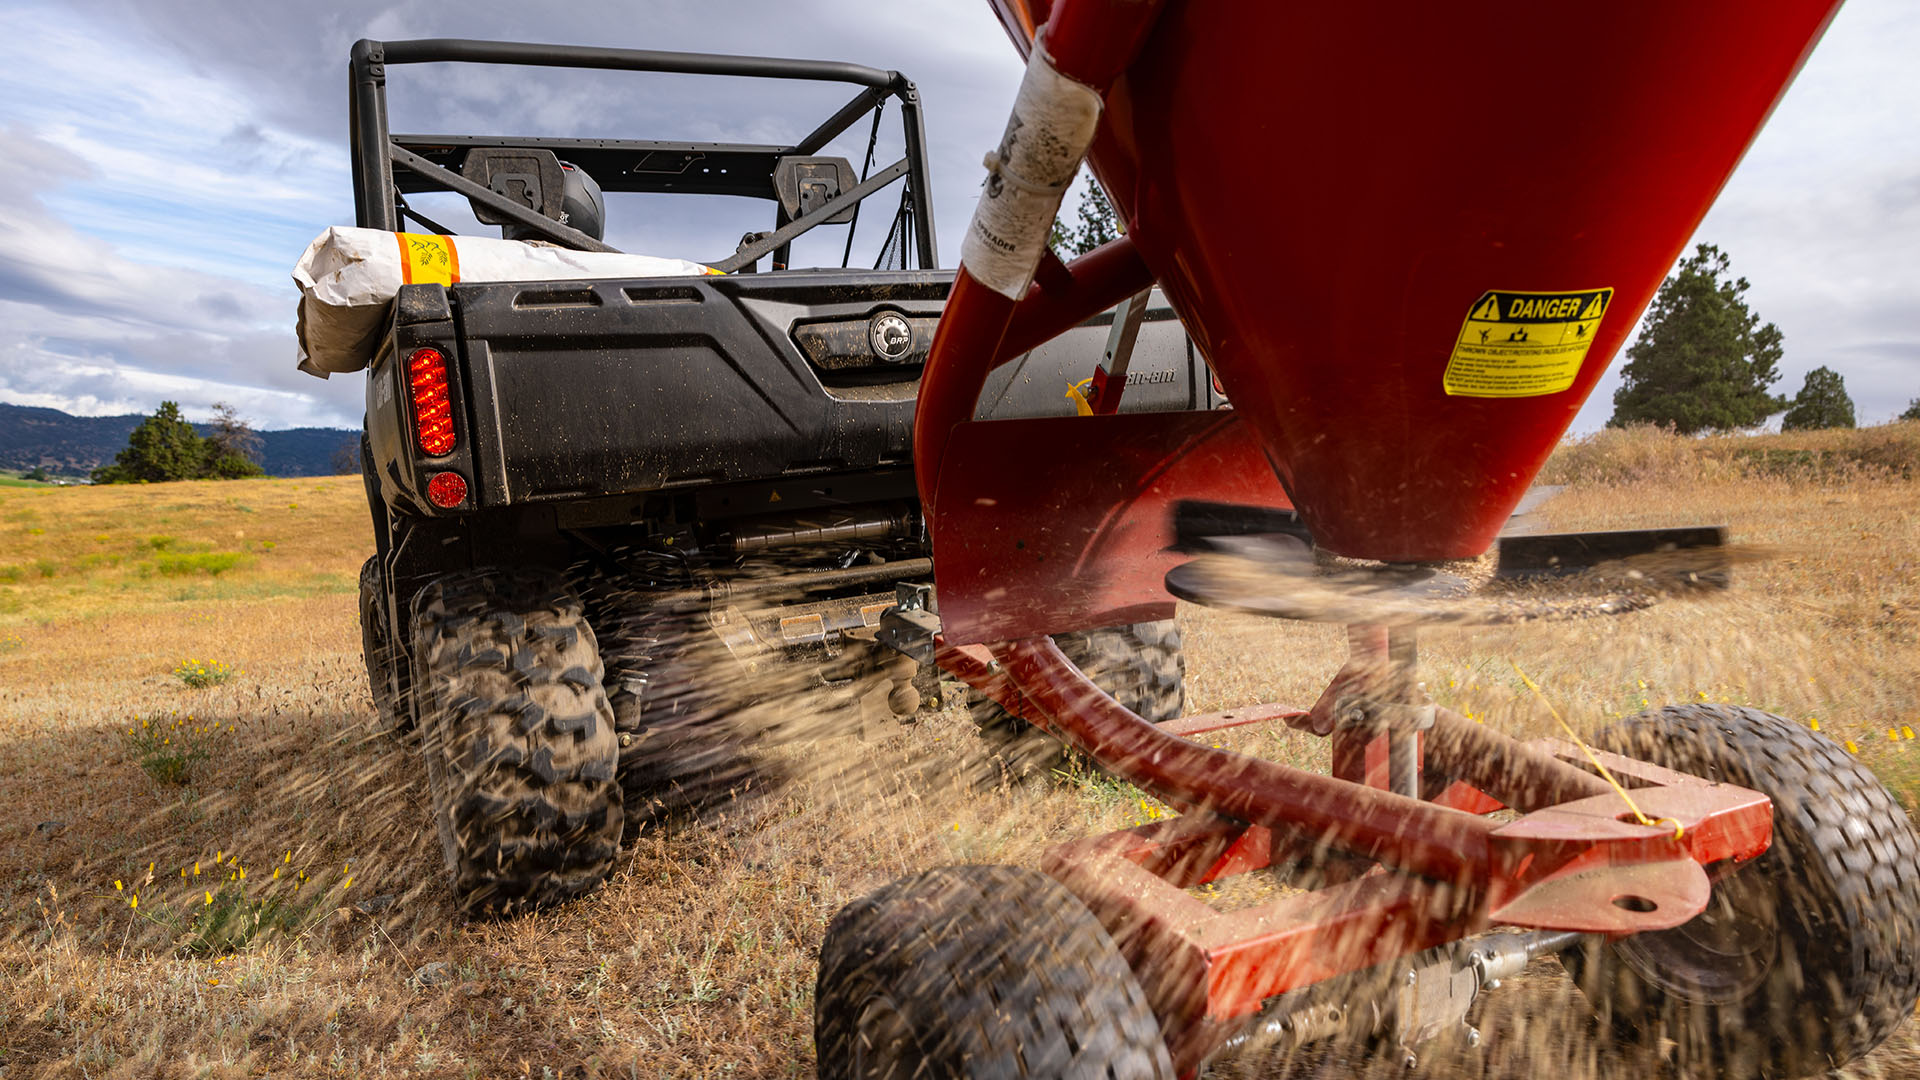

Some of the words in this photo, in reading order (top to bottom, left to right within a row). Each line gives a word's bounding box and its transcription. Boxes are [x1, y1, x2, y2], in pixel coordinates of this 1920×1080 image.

[977, 219, 1016, 252] SPREADER
[1507, 297, 1582, 319] DANGER
[1126, 368, 1176, 386] an-am
